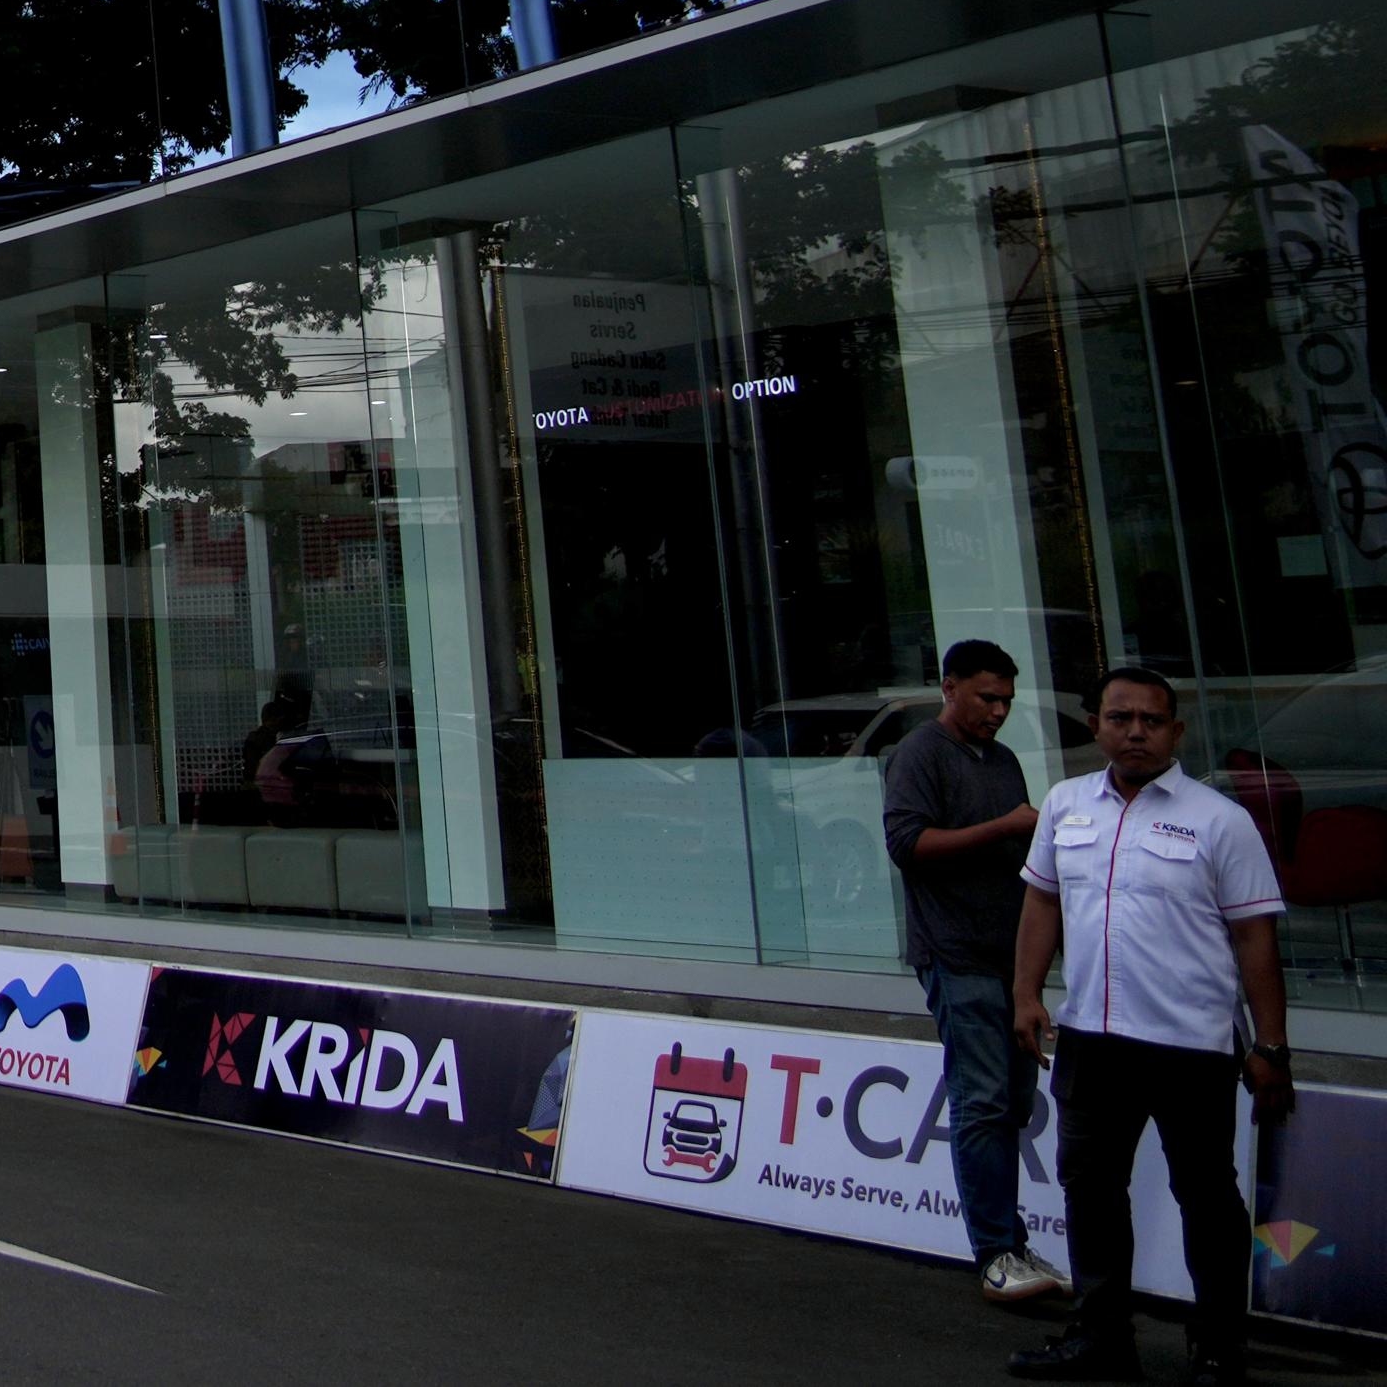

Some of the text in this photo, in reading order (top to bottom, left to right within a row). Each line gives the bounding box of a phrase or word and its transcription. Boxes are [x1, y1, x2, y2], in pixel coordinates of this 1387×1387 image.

[532, 406, 588, 430] OYOTA
[731, 374, 796, 401] OPTION
[757, 1163, 835, 1199] Always
[840, 1177, 909, 1213] Serve,
[1017, 1204, 1066, 1235] are
